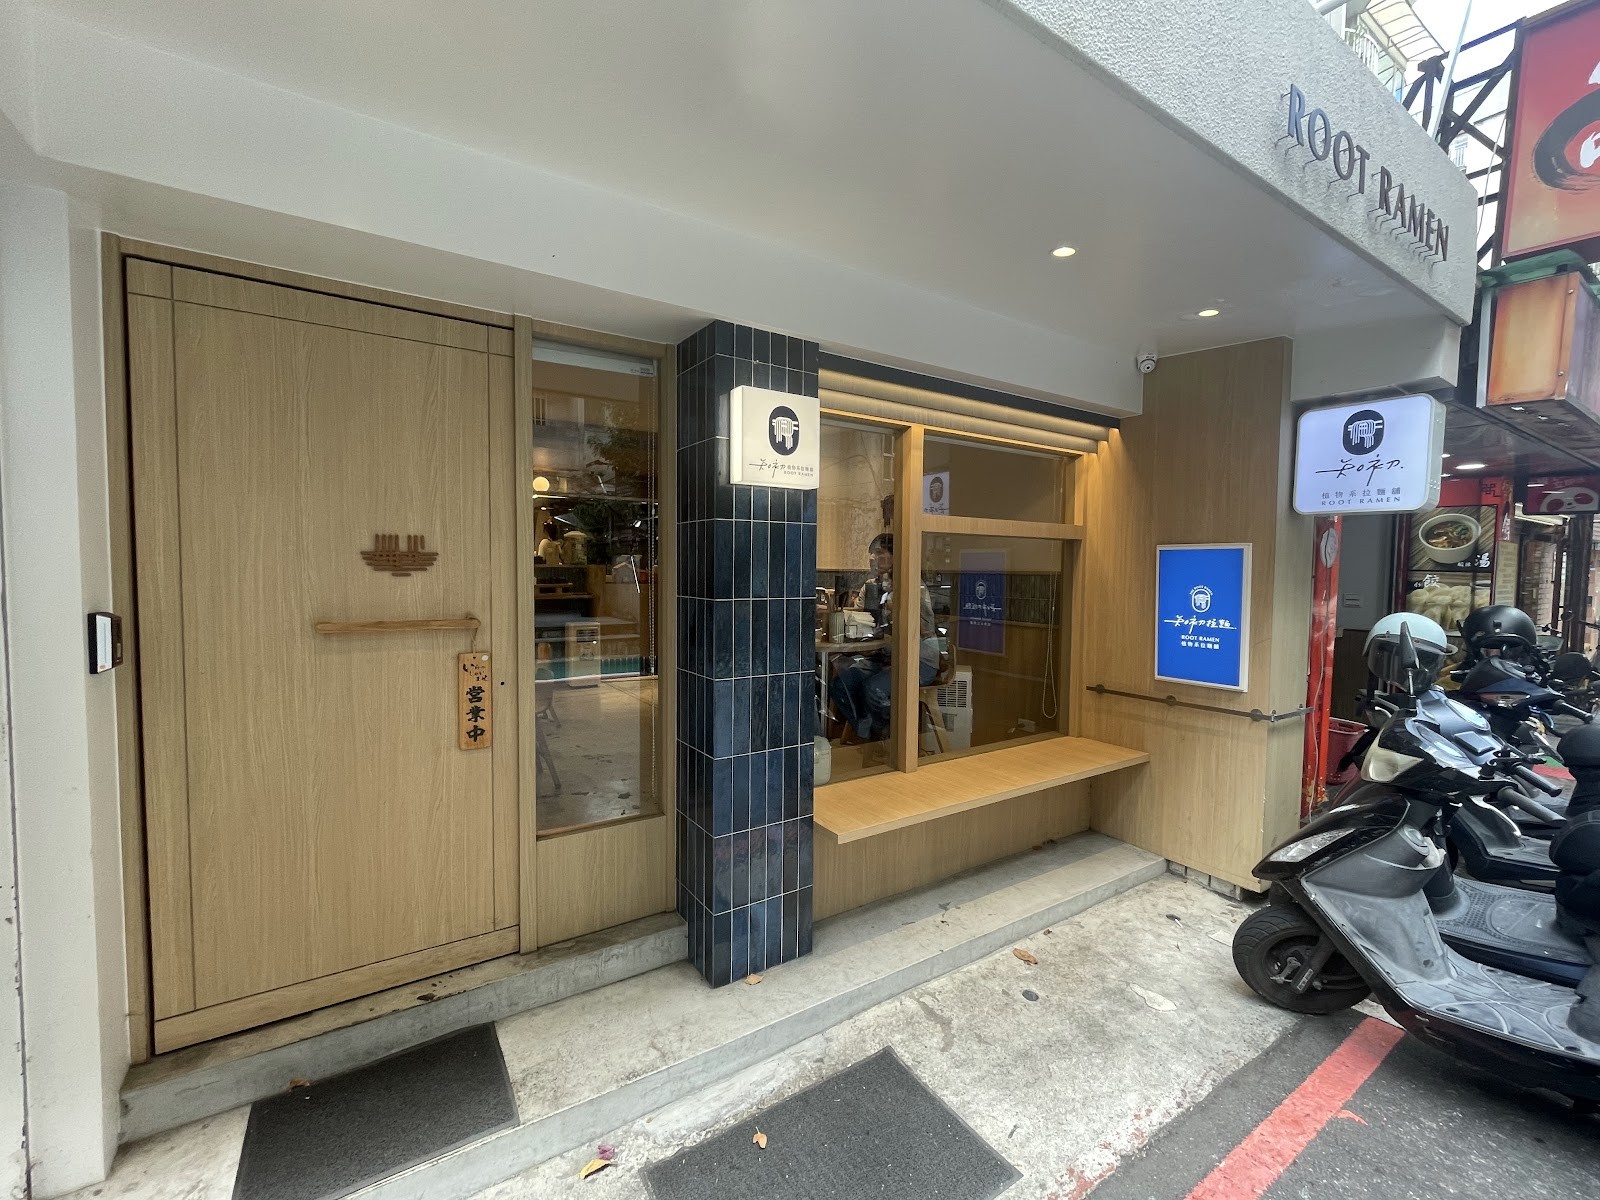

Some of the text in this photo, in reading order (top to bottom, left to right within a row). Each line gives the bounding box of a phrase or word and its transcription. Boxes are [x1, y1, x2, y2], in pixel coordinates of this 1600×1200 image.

[1287, 83, 1450, 262] ROOT RAMEN
[1359, 496, 1401, 504] RAMEN
